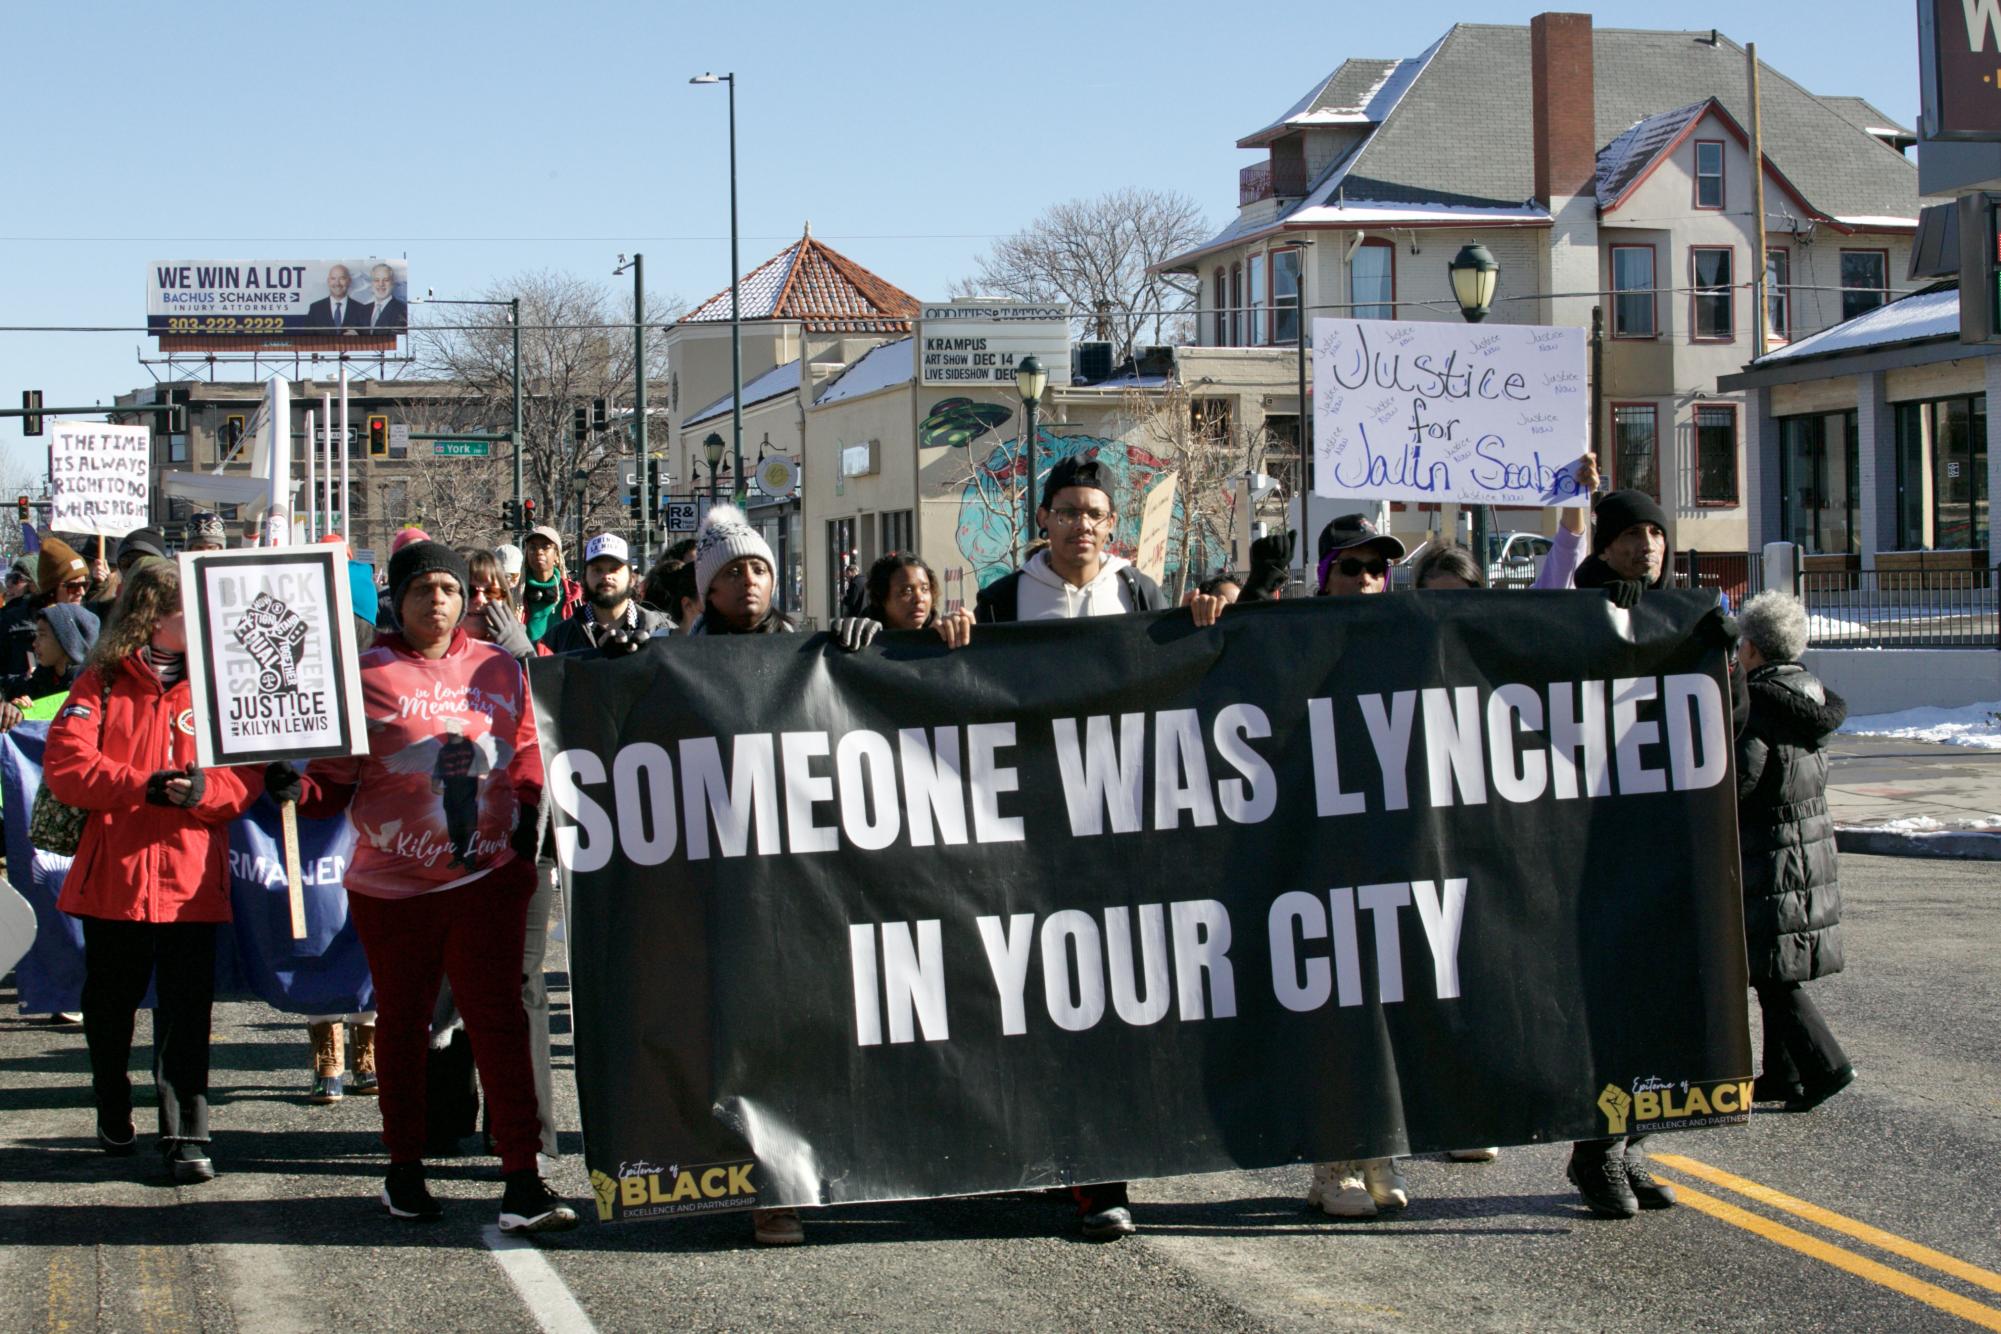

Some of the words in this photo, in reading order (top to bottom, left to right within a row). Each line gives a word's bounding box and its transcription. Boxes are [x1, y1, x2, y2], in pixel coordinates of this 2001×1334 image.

[157, 267, 191, 289] WE
[197, 267, 240, 289] WIN
[245, 267, 261, 289] A
[266, 267, 306, 289] LOT
[163, 293, 215, 303] BACHUS
[219, 293, 286, 303] SCHANKER
[174, 304, 215, 312] INJURY
[222, 304, 289, 312] ATTORNEYS
[1001, 308, 1065, 320] TATTOOS
[168, 317, 284, 334] 303-222-2222
[927, 338, 987, 351] KRAMPUS
[925, 353, 941, 365] ART
[943, 353, 968, 365] SHOW
[974, 353, 996, 365] DEC
[1001, 353, 1013, 365] 14
[1333, 324, 1530, 400] Justice
[925, 368, 943, 380] LIVE
[946, 368, 989, 380] SIDESHOW
[995, 368, 1017, 380] DEC
[1407, 398, 1460, 443] for
[60, 434, 96, 451] THE
[100, 434, 146, 451] TIME
[447, 444, 470, 454] York
[54, 456, 74, 472] IS
[79, 456, 147, 477] ALWAYS
[218, 573, 316, 607] BLACK
[299, 604, 325, 689] MATTER
[434, 681, 482, 702] loving
[398, 695, 496, 725] Memory
[242, 719, 281, 736] KILYN
[285, 716, 328, 733] LEWIS
[549, 722, 1026, 873] SOMEONE
[1052, 702, 1277, 837] WAS
[1308, 673, 1728, 818] LYNCHED
[849, 918, 950, 1046] IN
[976, 899, 1238, 1036] YOUR
[1267, 877, 1469, 1013] CITY
[1631, 1074, 1676, 1095] Epitome
[1680, 1079, 1689, 1094] of
[1634, 1081, 1754, 1120] BLACK
[1636, 1120, 1688, 1132] EXCELLENCE
[1689, 1118, 1706, 1128] AND
[618, 1159, 665, 1180] Epitome
[669, 1162, 679, 1178] of
[620, 1164, 757, 1206] BLACK
[623, 1205, 675, 1218] EXCELLENCE
[677, 1202, 696, 1213] AND
[697, 1197, 756, 1211] PARTNERSHIP
